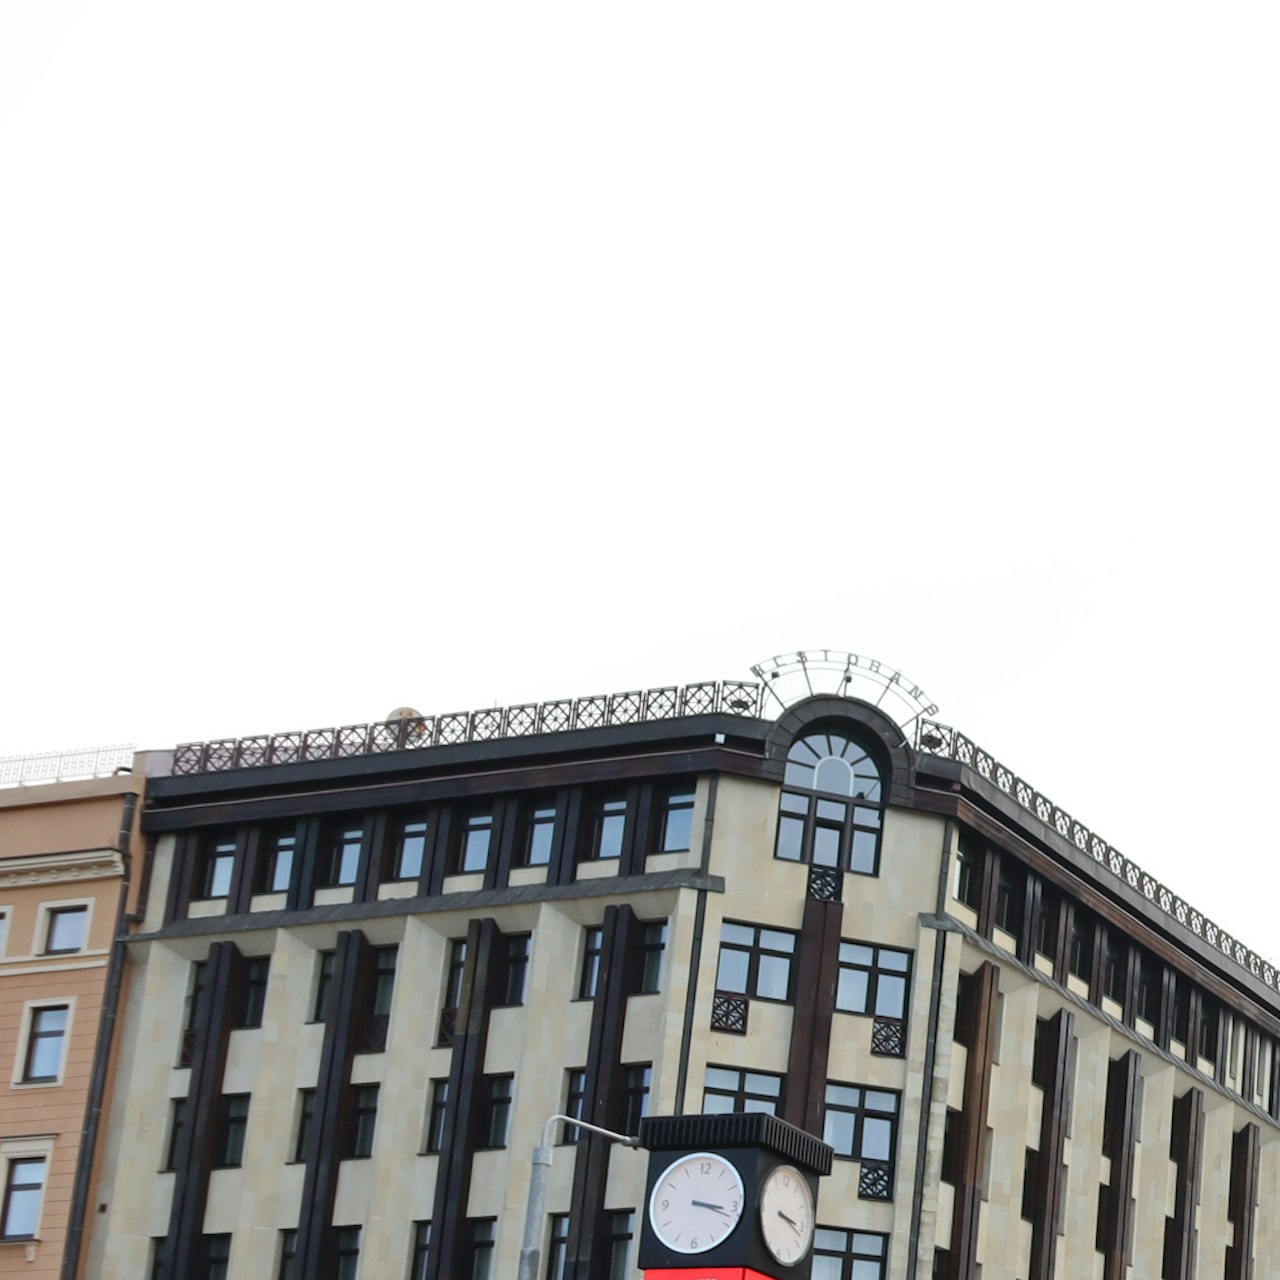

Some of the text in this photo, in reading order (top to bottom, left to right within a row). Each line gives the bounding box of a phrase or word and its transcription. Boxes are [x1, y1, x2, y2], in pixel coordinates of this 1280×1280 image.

[700, 1162, 712, 1175] 12
[782, 1175, 790, 1188] 12
[661, 1199, 670, 1211] 9
[730, 1200, 738, 1212] 3
[690, 1237, 698, 1249] 6
